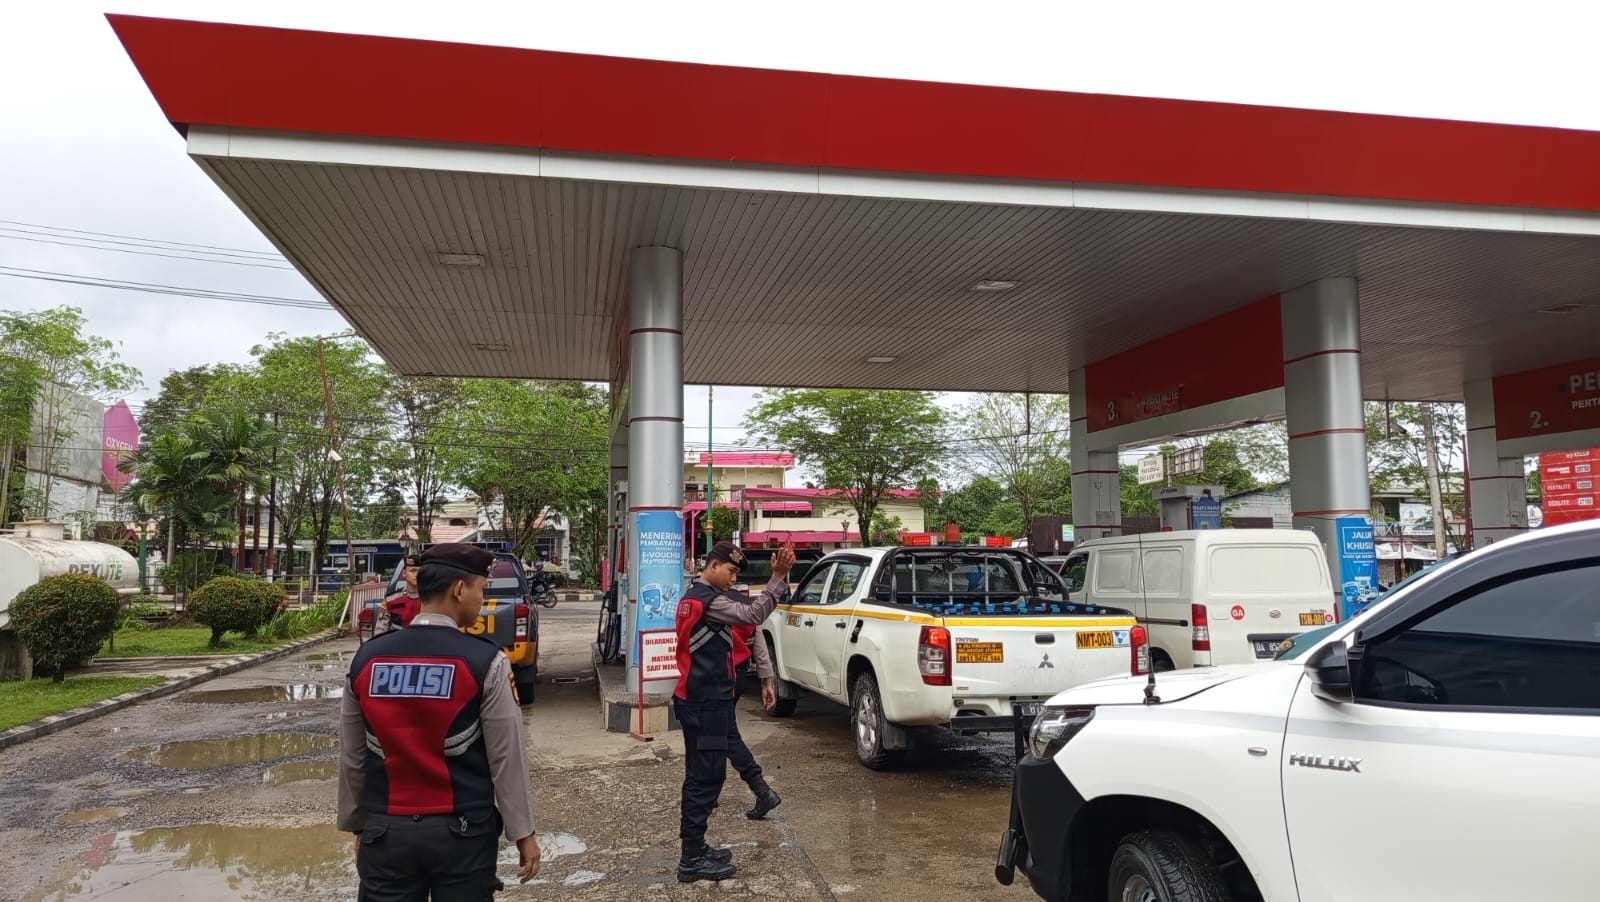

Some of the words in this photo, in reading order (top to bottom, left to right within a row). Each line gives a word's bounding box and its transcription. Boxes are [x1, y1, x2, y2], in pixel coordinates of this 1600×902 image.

[1530, 410, 1549, 429] 2.
[1076, 632, 1112, 647] NMT-003
[372, 665, 451, 696] POLISI
[1289, 751, 1362, 773] HILUX
